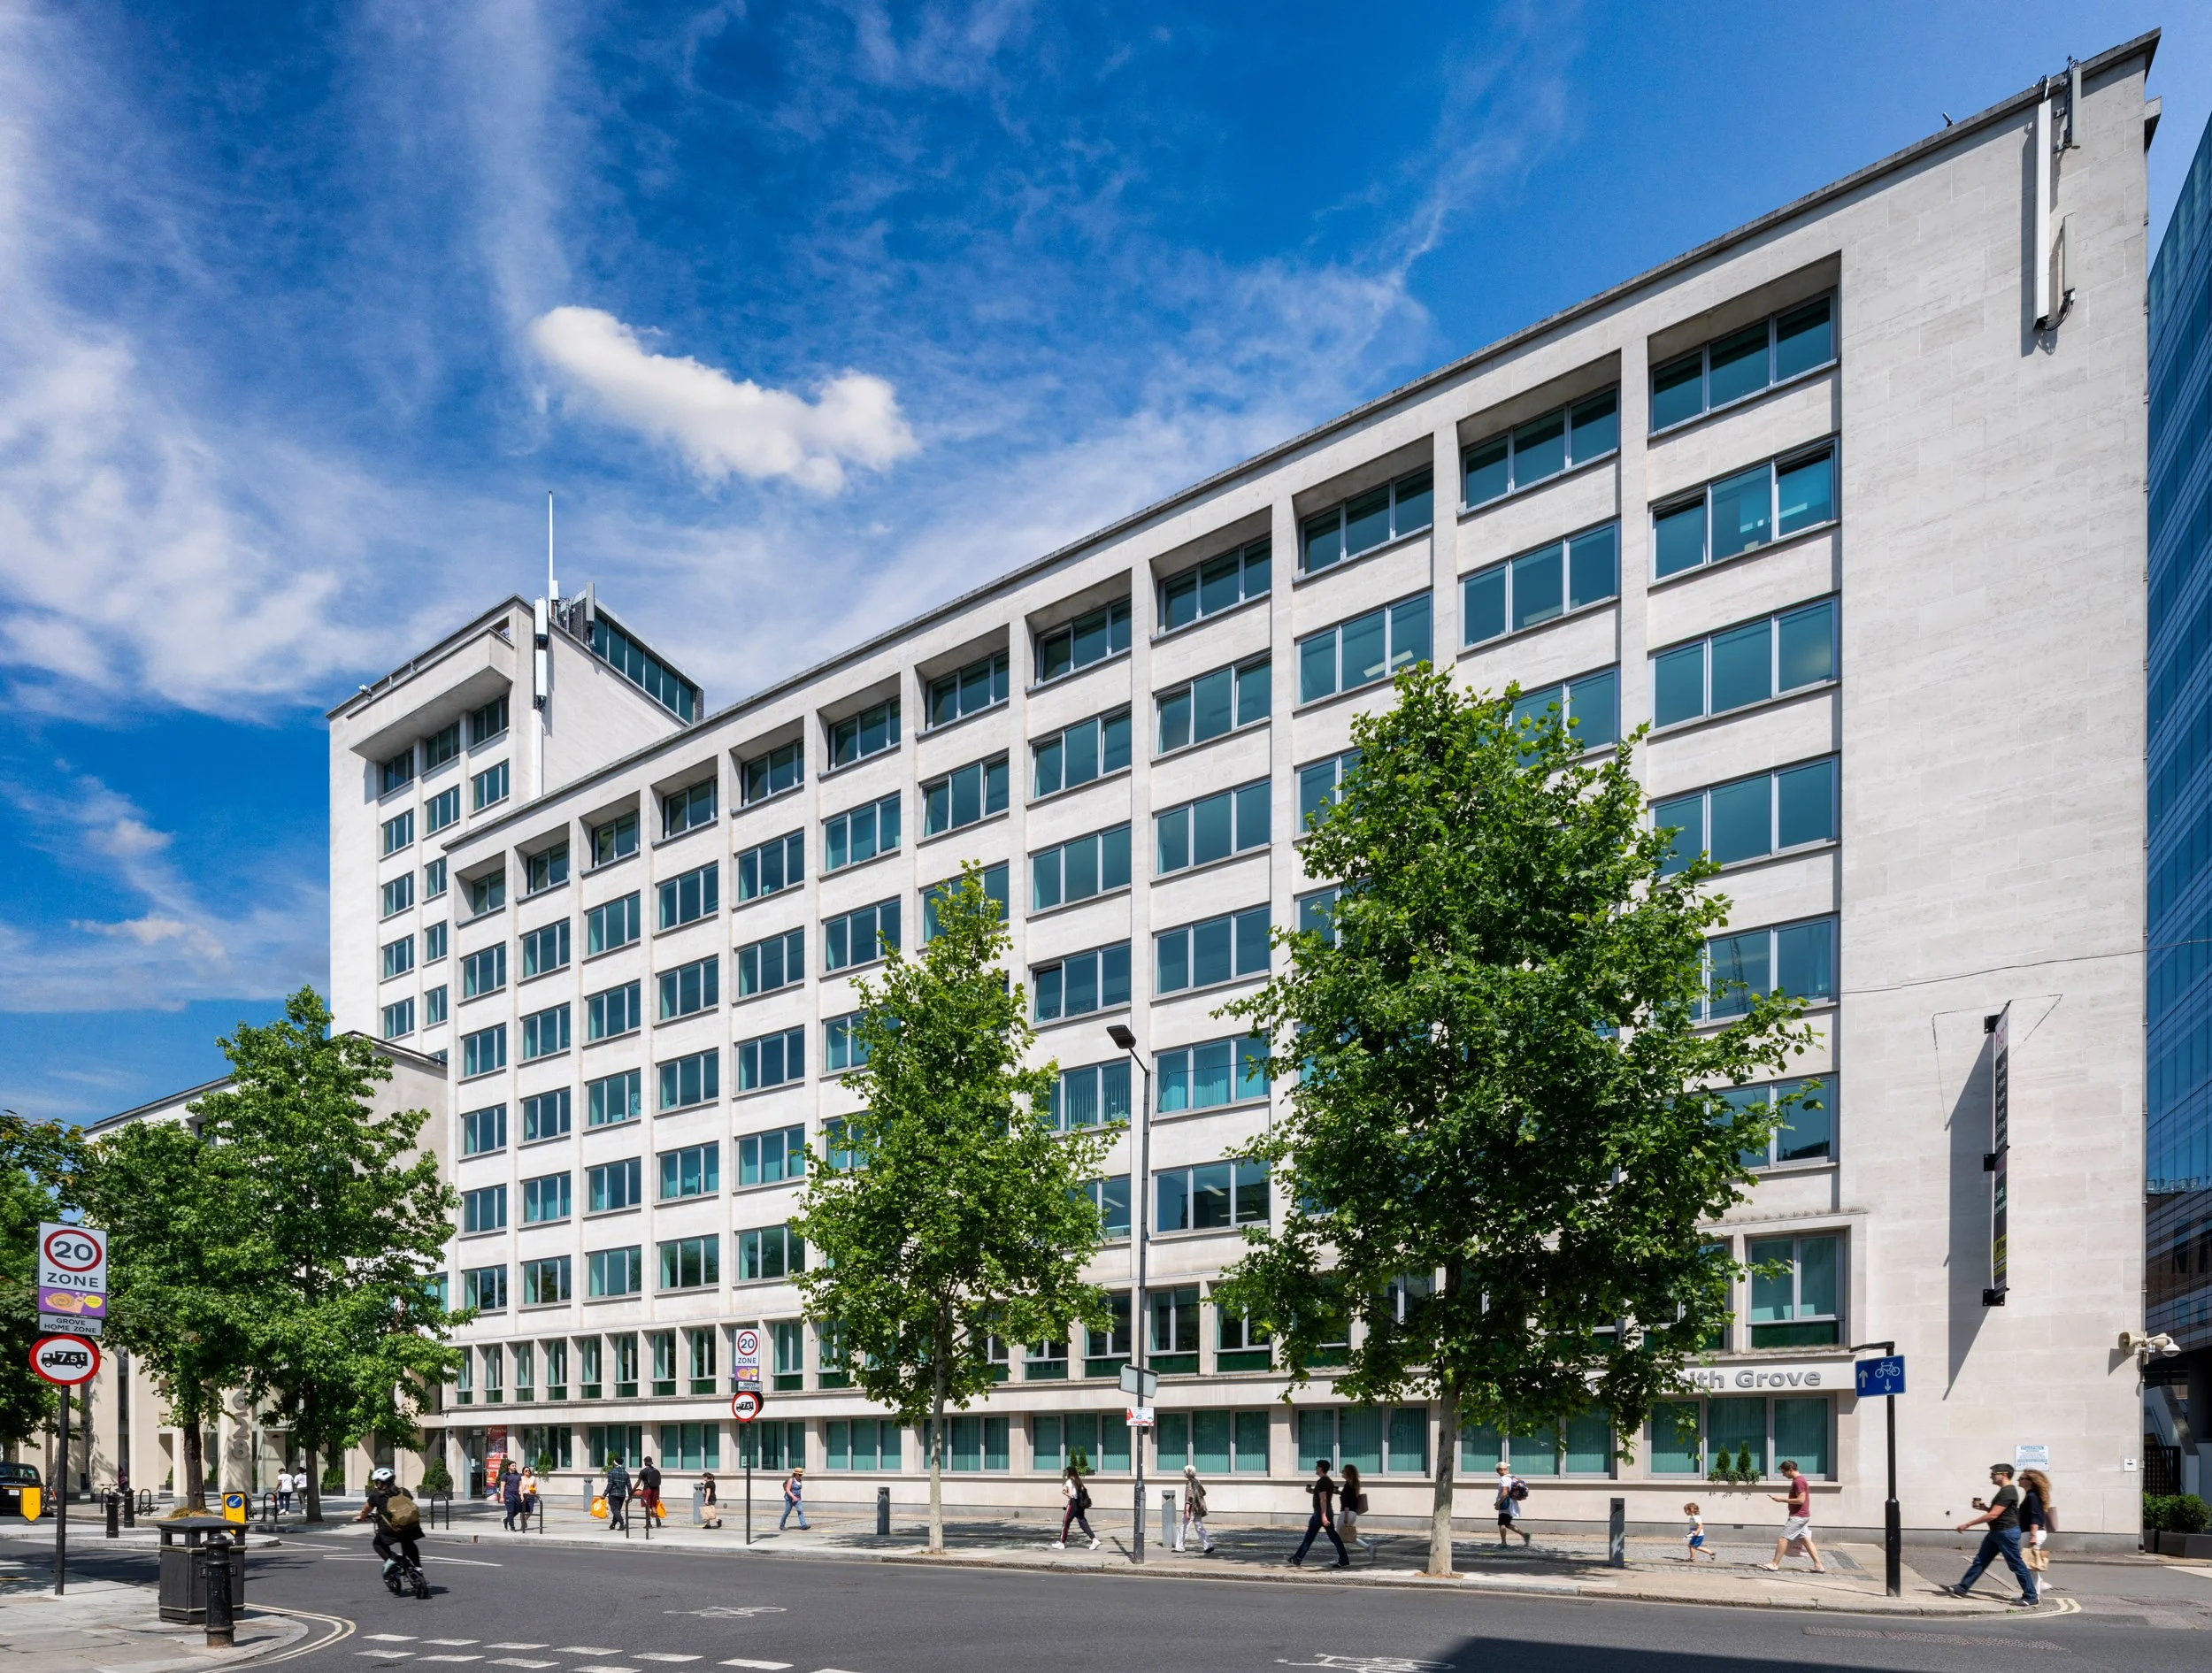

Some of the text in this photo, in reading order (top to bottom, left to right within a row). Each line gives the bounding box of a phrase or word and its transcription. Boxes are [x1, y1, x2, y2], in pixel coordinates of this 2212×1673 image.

[54, 1240, 93, 1262] 20
[47, 1271, 99, 1288] ZONE
[56, 1317, 86, 1326] GROVE
[741, 1339, 755, 1348] 20
[1735, 1370, 1822, 1388] Grove
